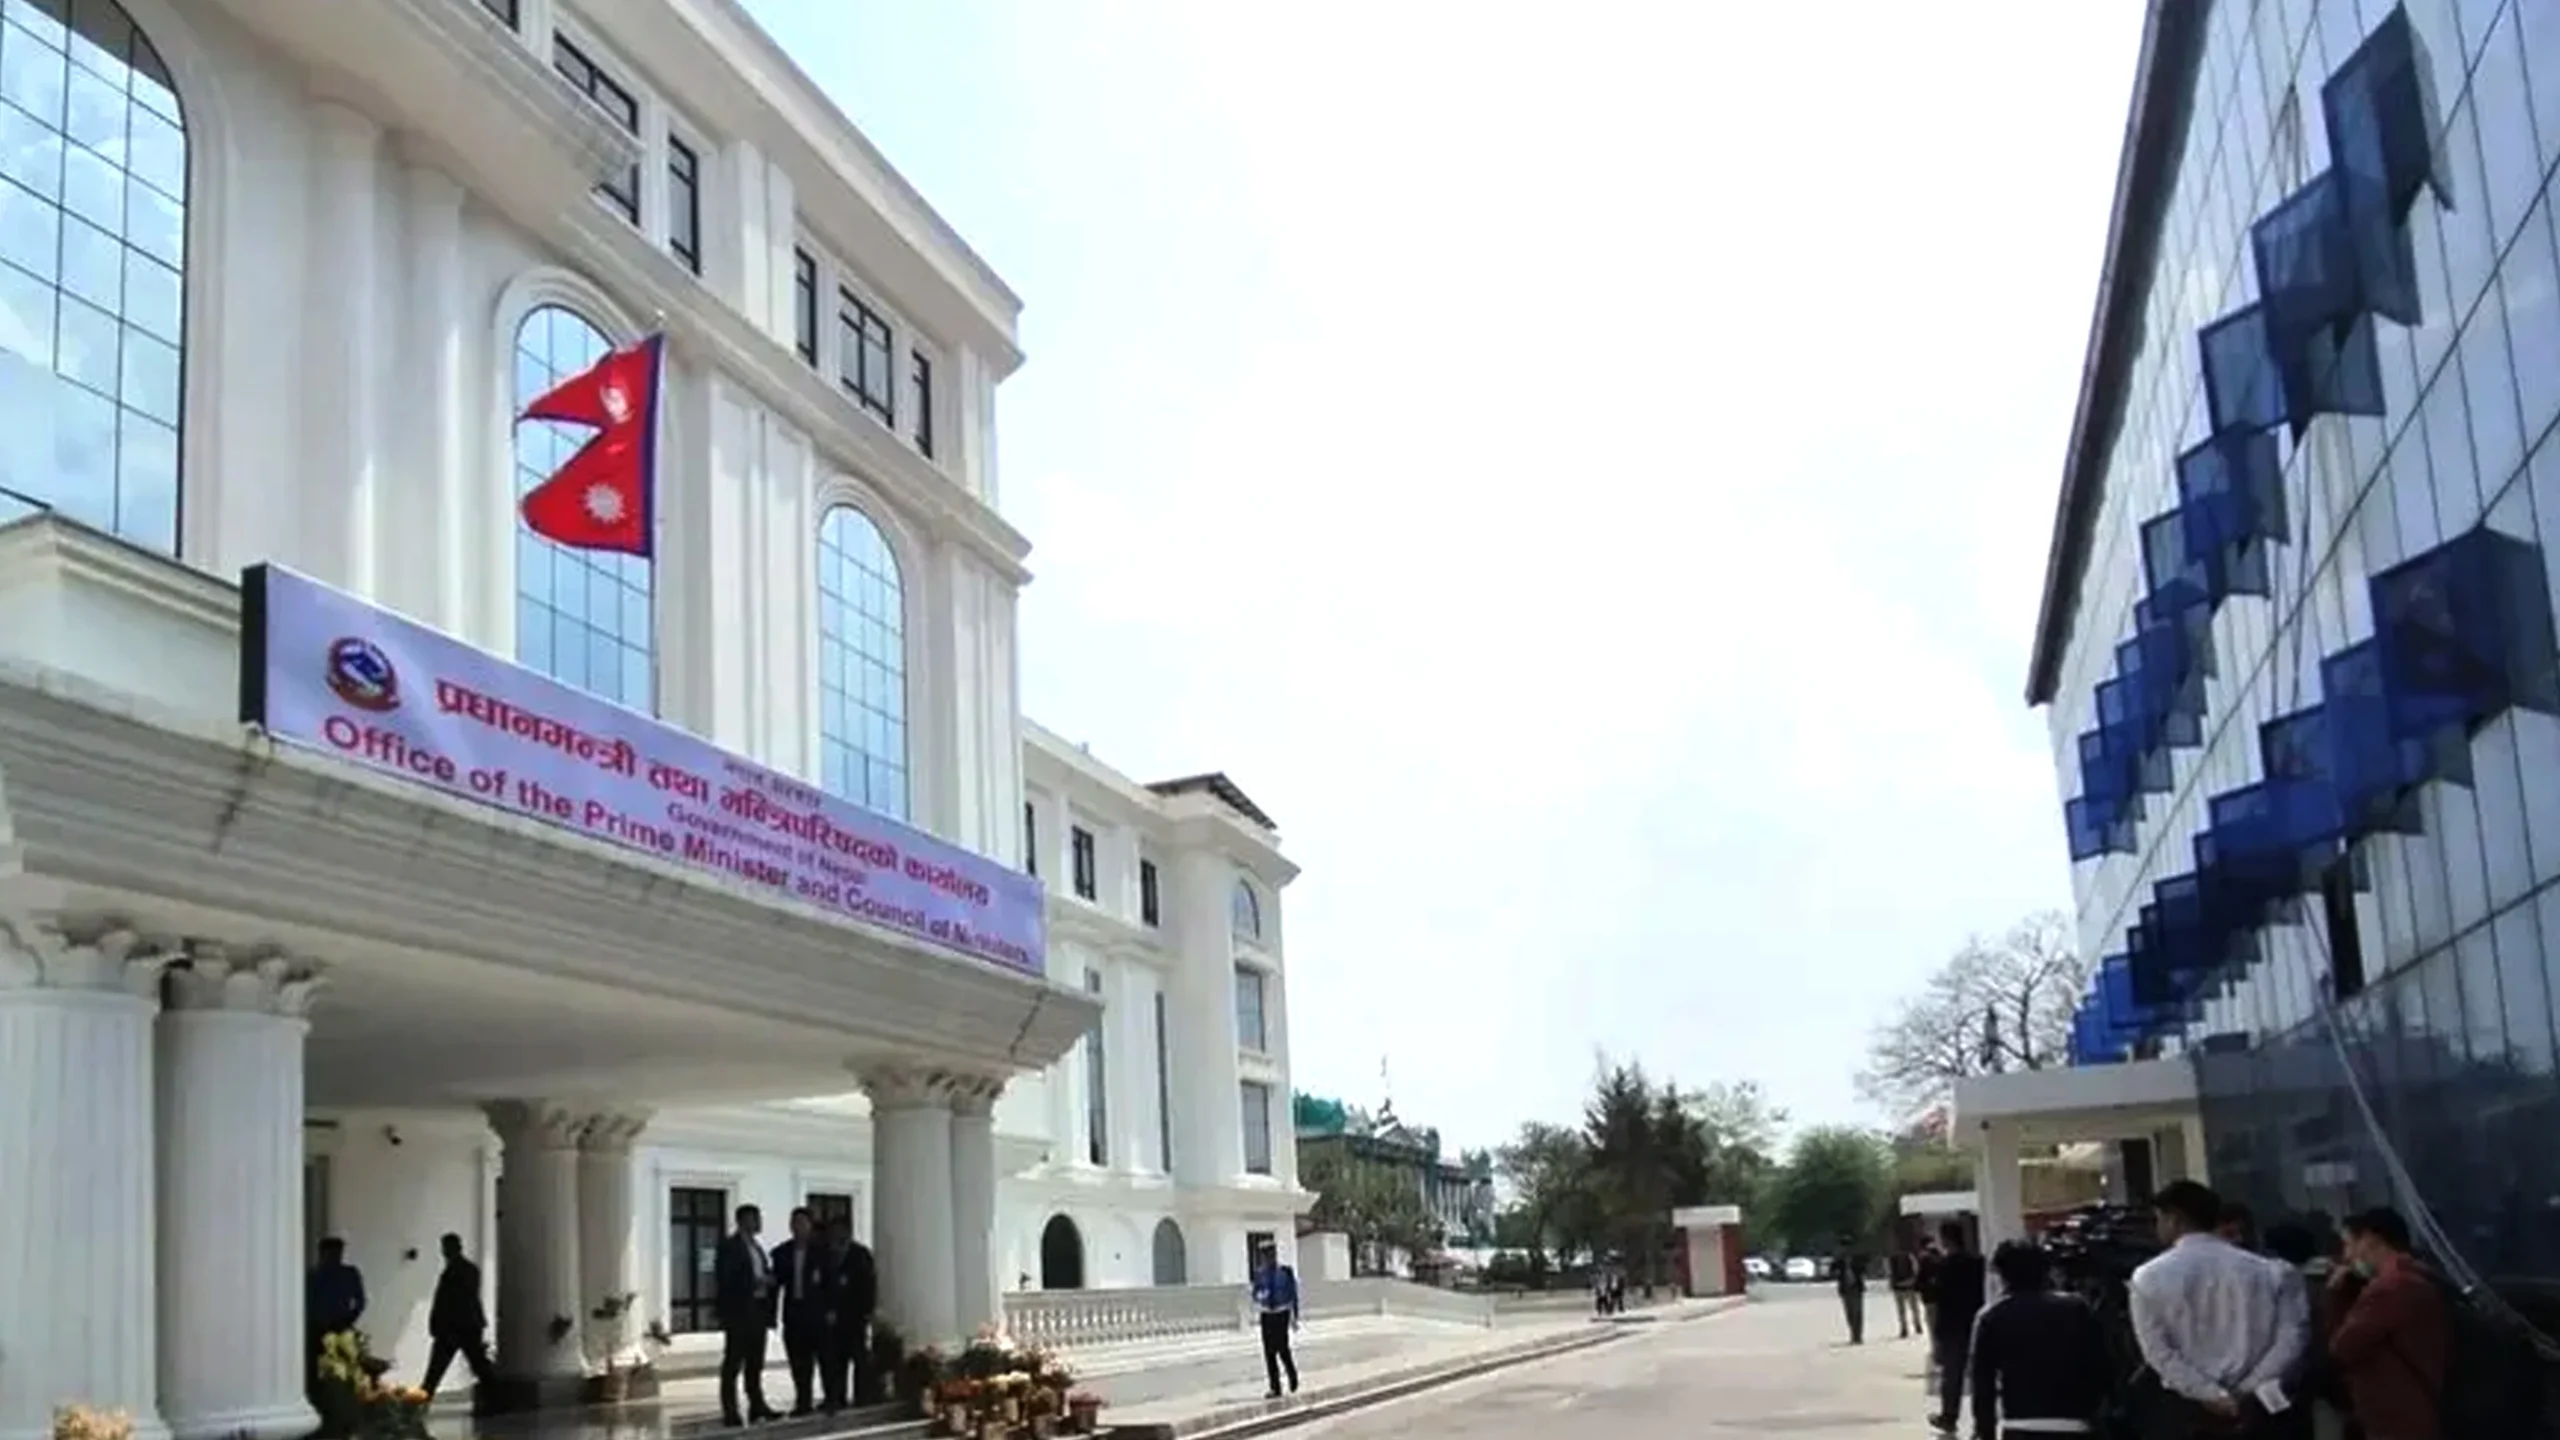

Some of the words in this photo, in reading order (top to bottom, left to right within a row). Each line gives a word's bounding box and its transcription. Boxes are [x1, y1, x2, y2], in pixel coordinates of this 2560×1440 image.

[436, 679, 635, 777] प्रधानमन्त्री
[648, 758, 709, 804] तथा
[325, 715, 455, 783] Office
[469, 769, 506, 797] of
[518, 779, 573, 819] the
[584, 799, 675, 852] Prime
[684, 832, 789, 887] Minister
[797, 874, 840, 902] and
[847, 886, 926, 932] Council
[930, 919, 950, 939] of
[667, 802, 793, 861] Government
[797, 847, 814, 866] of
[819, 855, 867, 885] Nepal
